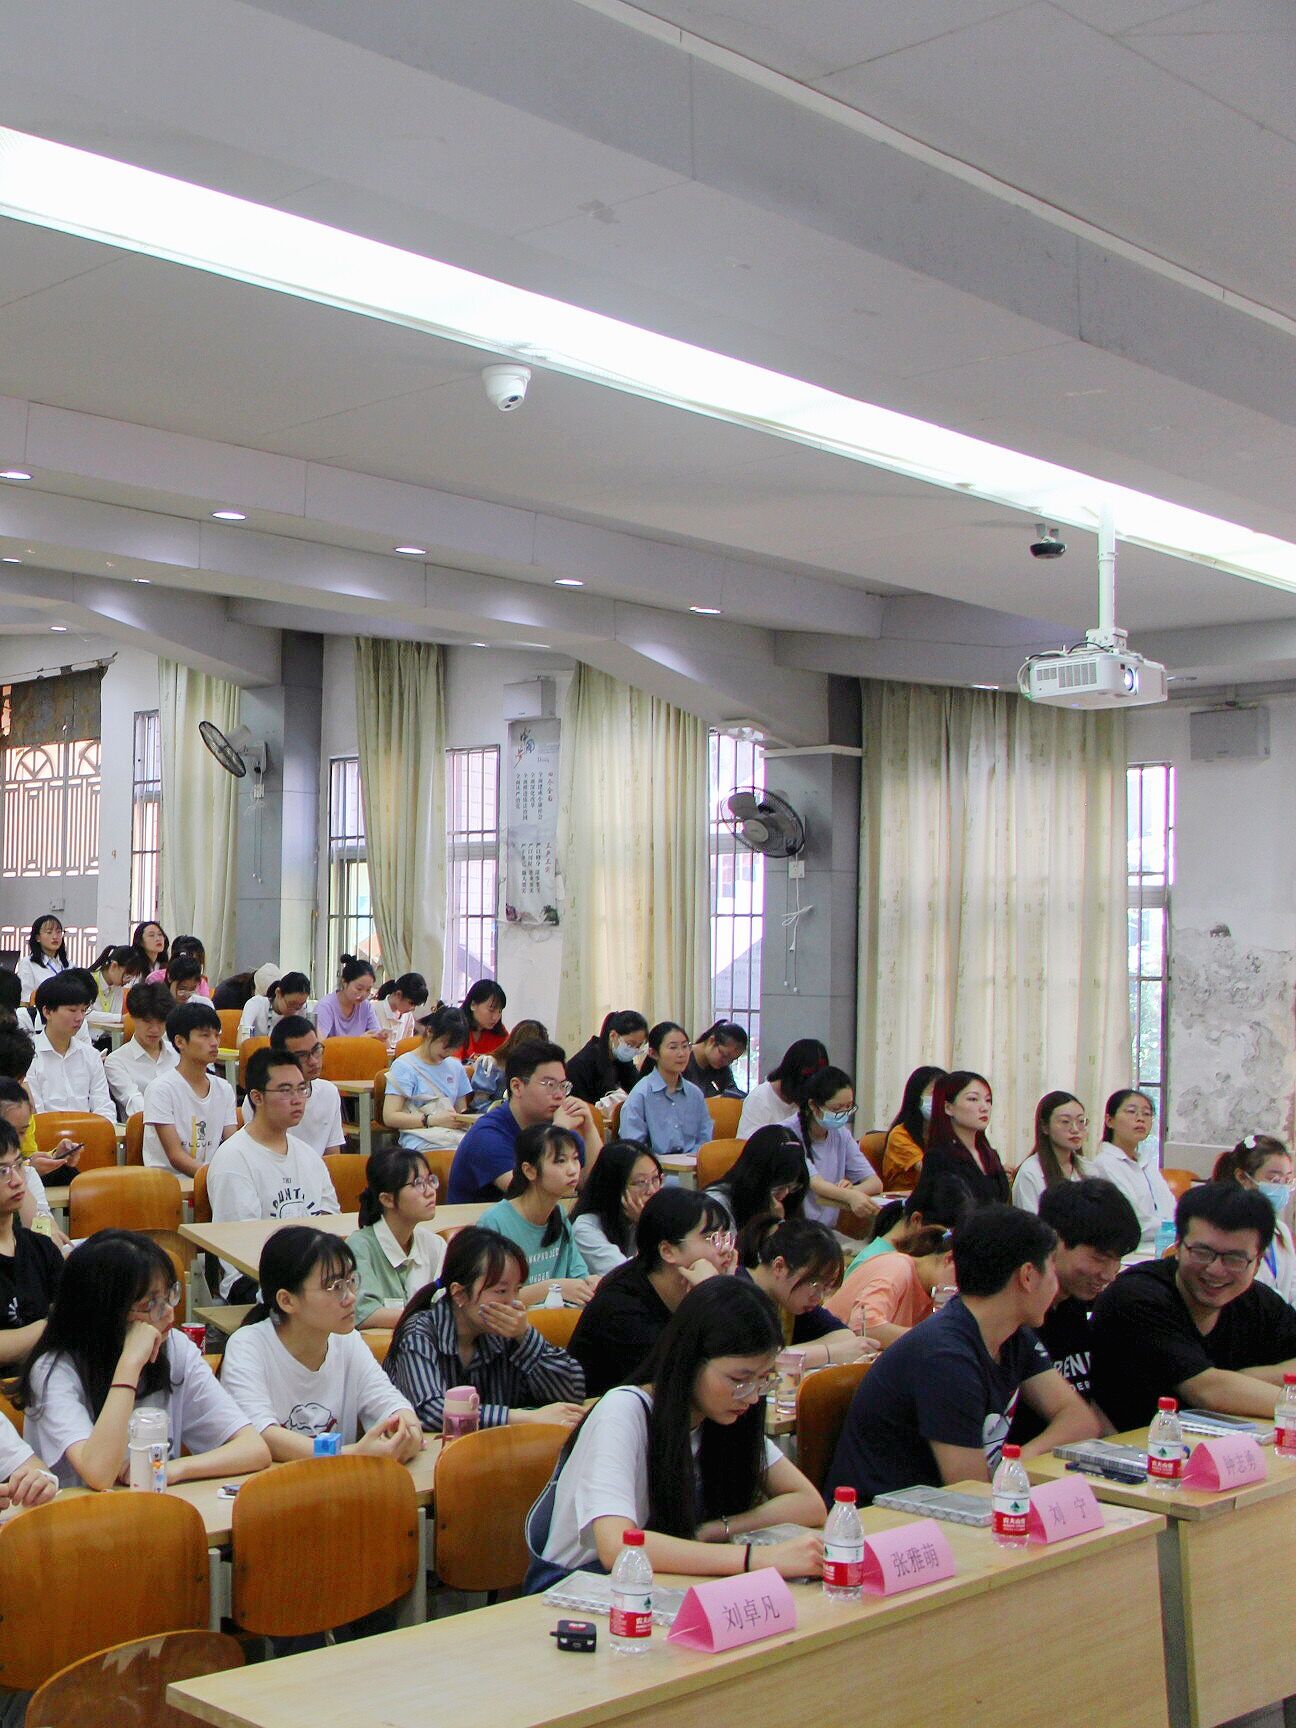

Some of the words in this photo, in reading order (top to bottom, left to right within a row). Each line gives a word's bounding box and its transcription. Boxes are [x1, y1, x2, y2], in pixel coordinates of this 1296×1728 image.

[889, 1542, 940, 1578] 张雅萌
[722, 1594, 781, 1633] 刘卓凡
